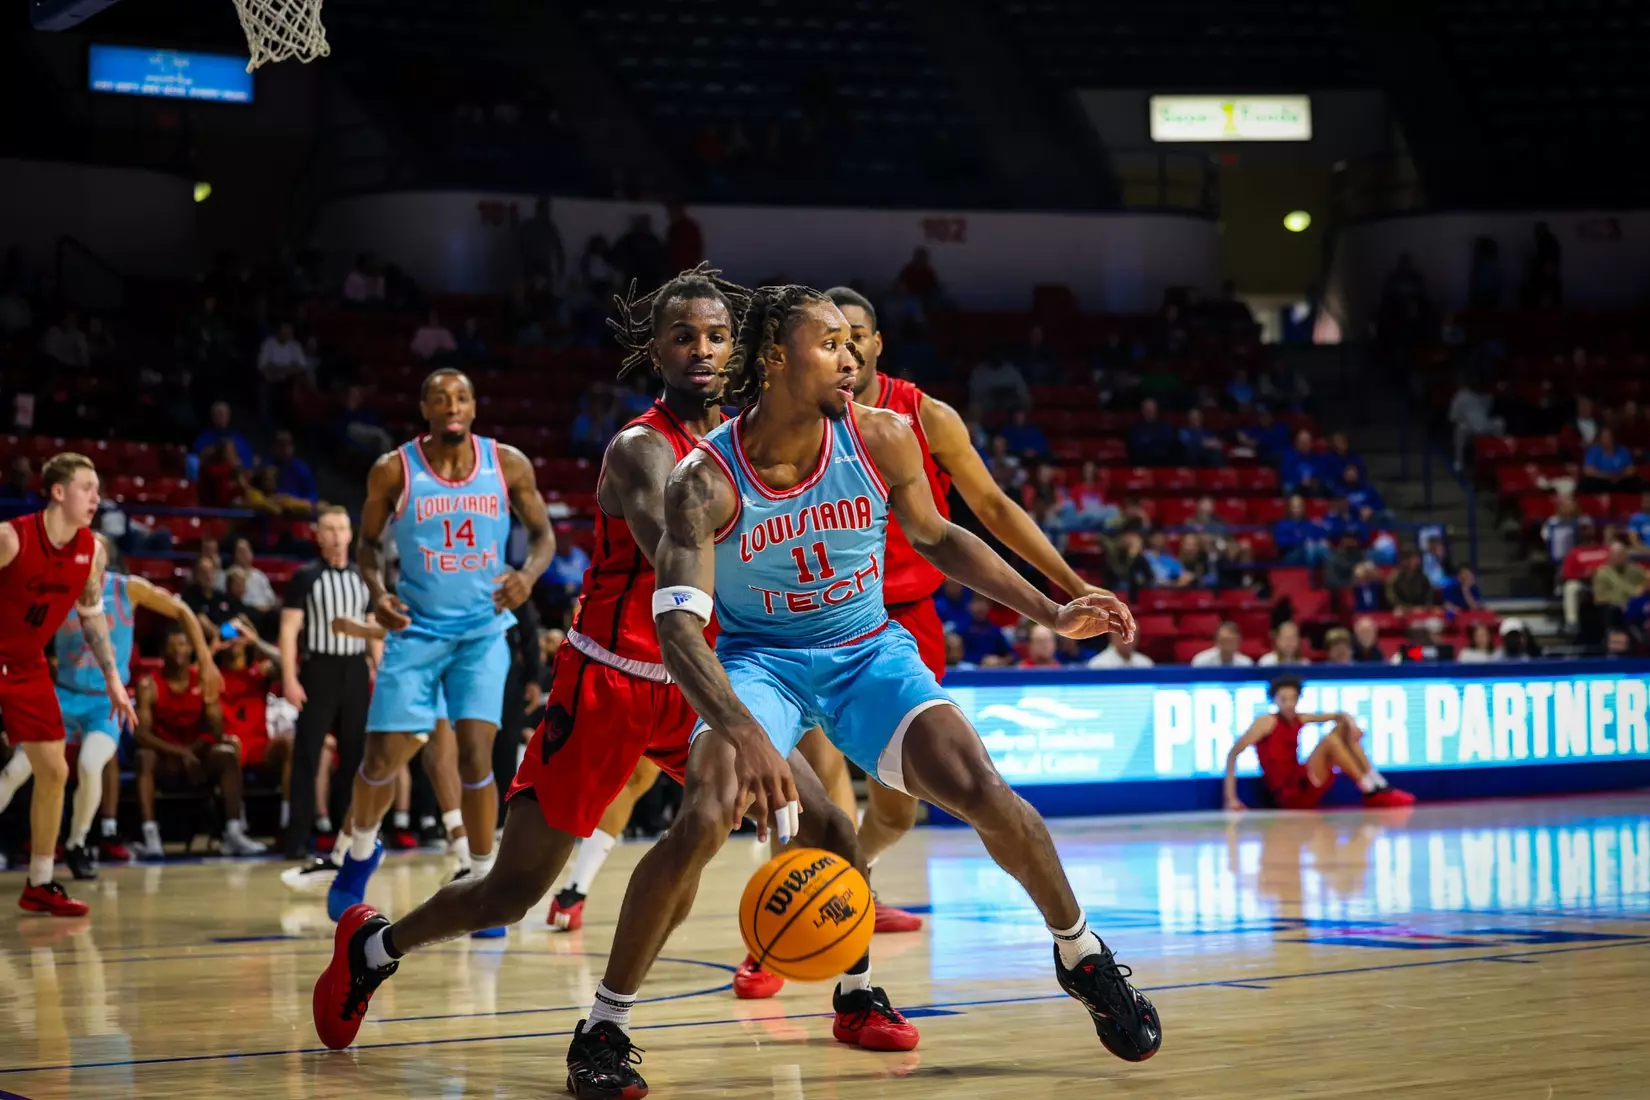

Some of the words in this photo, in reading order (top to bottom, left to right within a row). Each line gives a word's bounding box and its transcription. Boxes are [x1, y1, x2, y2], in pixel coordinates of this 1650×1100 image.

[415, 494, 498, 524] LOUISIANA
[740, 495, 872, 562] LOUISIANA
[443, 517, 476, 549] 14
[419, 541, 498, 573] TECH
[791, 541, 836, 584] 11
[749, 551, 880, 615] TECH
[765, 856, 837, 916] Wilson
